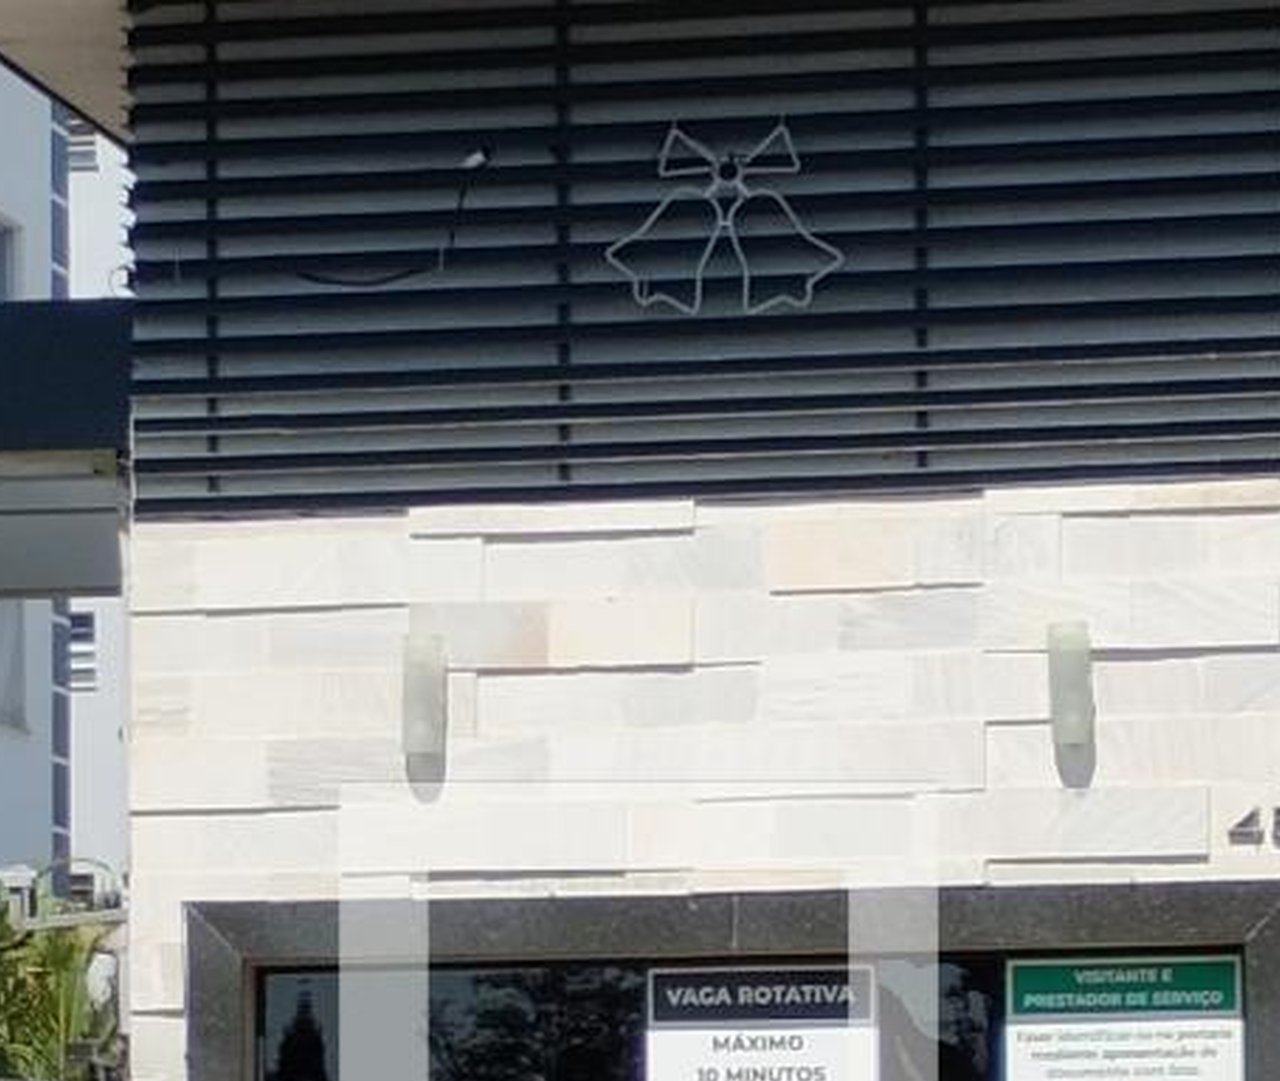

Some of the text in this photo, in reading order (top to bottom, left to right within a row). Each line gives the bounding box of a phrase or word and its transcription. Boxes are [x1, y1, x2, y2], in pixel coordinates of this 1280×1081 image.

[1073, 968, 1174, 983] VISITANTE E
[666, 984, 856, 1006] VAGA ROTATIVA
[1023, 989, 1224, 1009] PRESTADOR DE SERVIÇO
[712, 1034, 805, 1052] MÁXIMO
